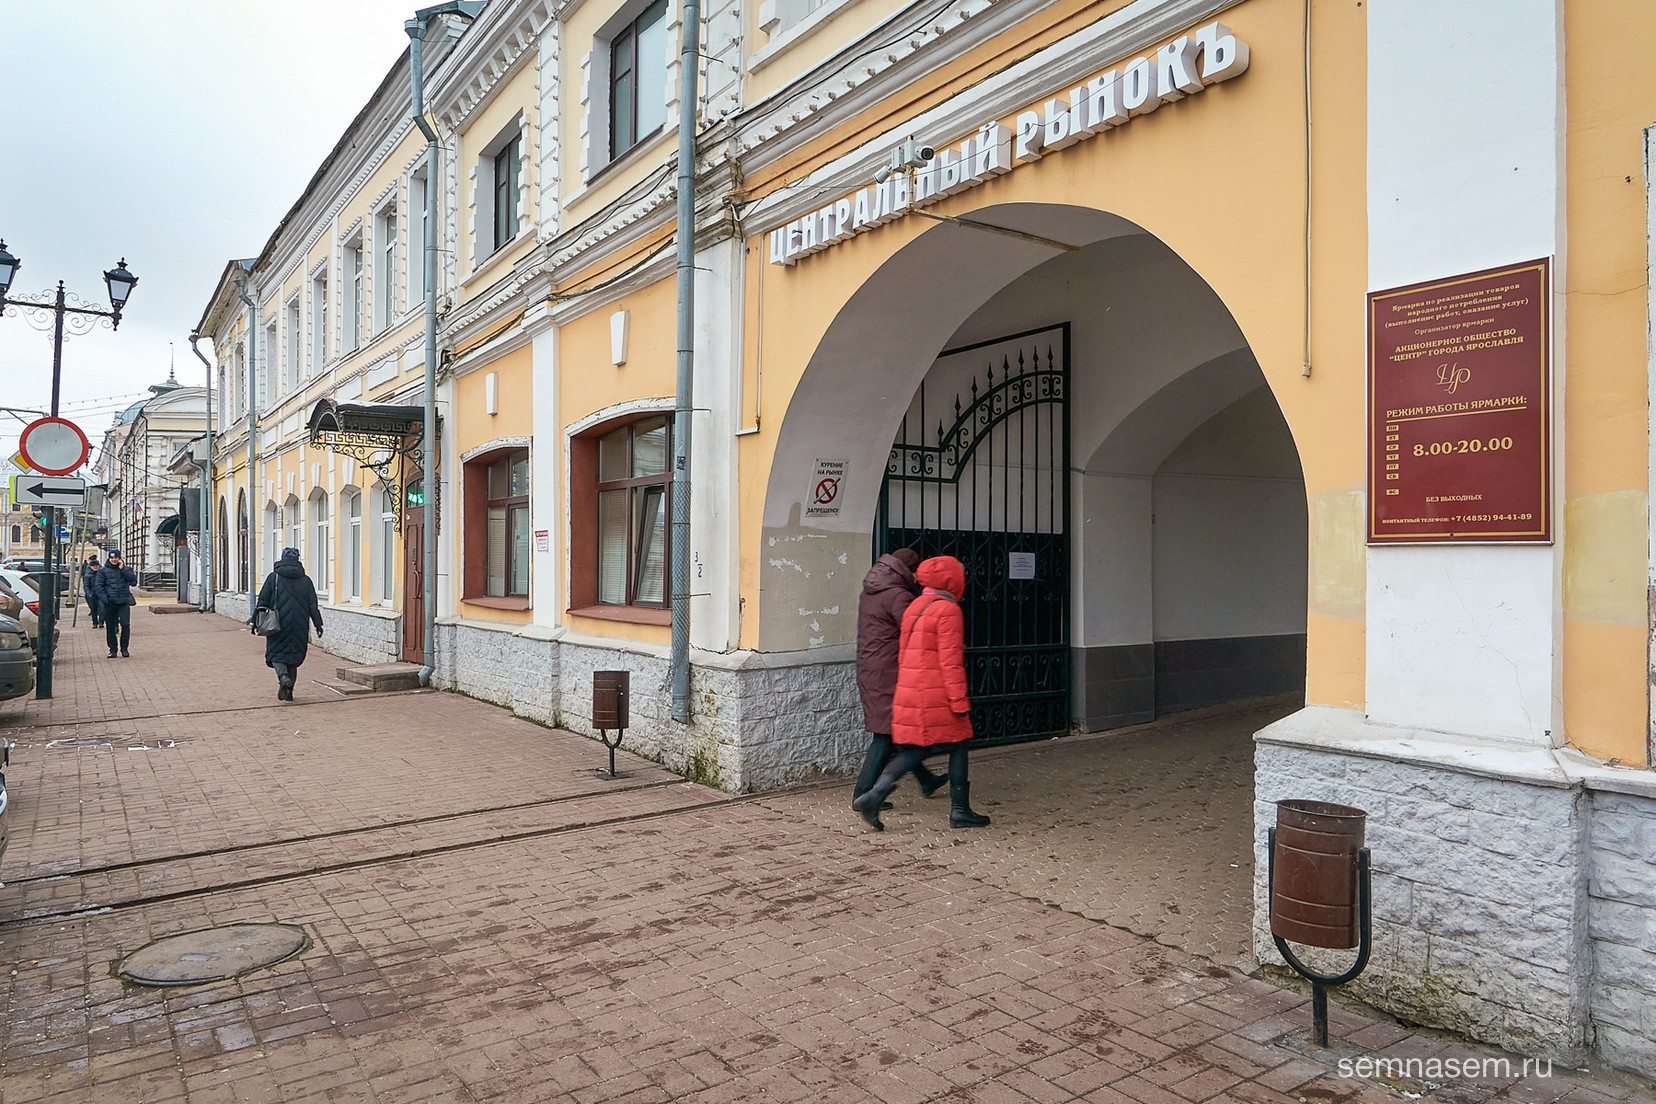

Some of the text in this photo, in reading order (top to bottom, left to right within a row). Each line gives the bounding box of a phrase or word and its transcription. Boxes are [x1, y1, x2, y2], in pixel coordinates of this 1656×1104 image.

[769, 20, 1249, 266] ЦЕНТРАЛЬНЫЙ РЫНОКЪ
[1392, 301, 1424, 312] Ярмарка
[1436, 290, 1484, 305] реализации
[1485, 283, 1520, 294] товаров
[1407, 295, 1503, 317] народного потребления
[1385, 297, 1529, 329] (выполнение работ, оказание услуг)
[1414, 317, 1495, 336] Организатор ярмарки
[1395, 328, 1516, 353] АКЦИОНЕРНОЕ ОБЩЕСТВО
[1428, 345, 1464, 357] ГОРОДА
[1466, 335, 1524, 351] ЯРОСЛАВЛЯ
[1386, 395, 1527, 418] РЕЖИМ РАБОТЫ ЯРМАРКИ:
[1412, 436, 1513, 457] 8.00-20.00
[1440, 494, 1483, 502] ВЫХОДНЫХ
[1463, 514, 1491, 523] (4852)
[1493, 513, 1532, 522] 94-41-89
